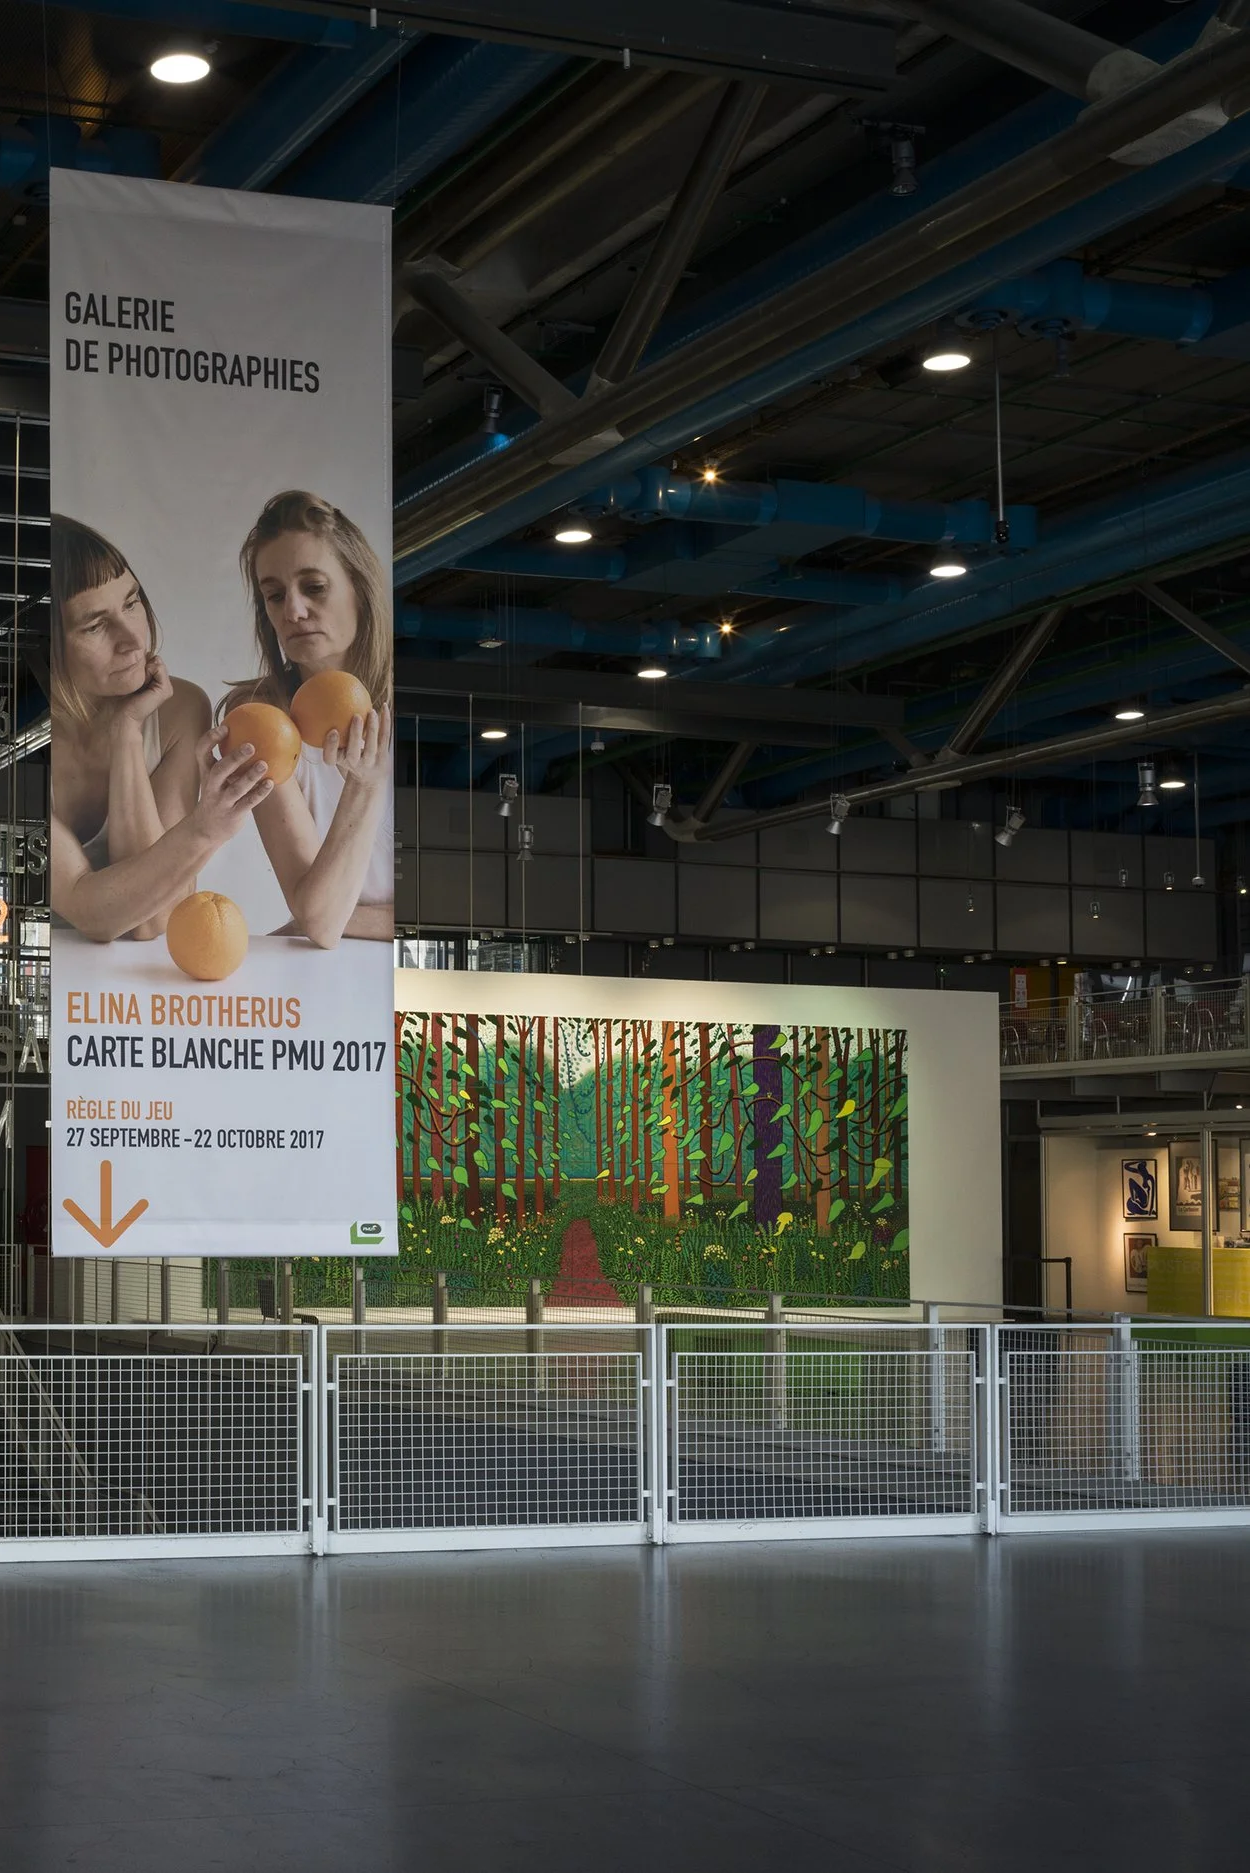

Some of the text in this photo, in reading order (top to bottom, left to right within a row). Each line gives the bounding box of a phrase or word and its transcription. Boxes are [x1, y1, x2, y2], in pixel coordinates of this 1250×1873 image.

[65, 291, 175, 333] GALERIE
[65, 338, 320, 394] DE PHOTOGRAPHIES
[66, 991, 301, 1029] ELINA BROTHERUS
[66, 1035, 386, 1072] CARTE BLANCHE PMU 2017
[66, 1095, 173, 1121] RÈGLE DU JEU
[66, 1127, 85, 1148] 27
[90, 1127, 181, 1148] SEPTEMBRE
[217, 1129, 285, 1149] OCTOBRE
[290, 1130, 325, 1149] 2017
